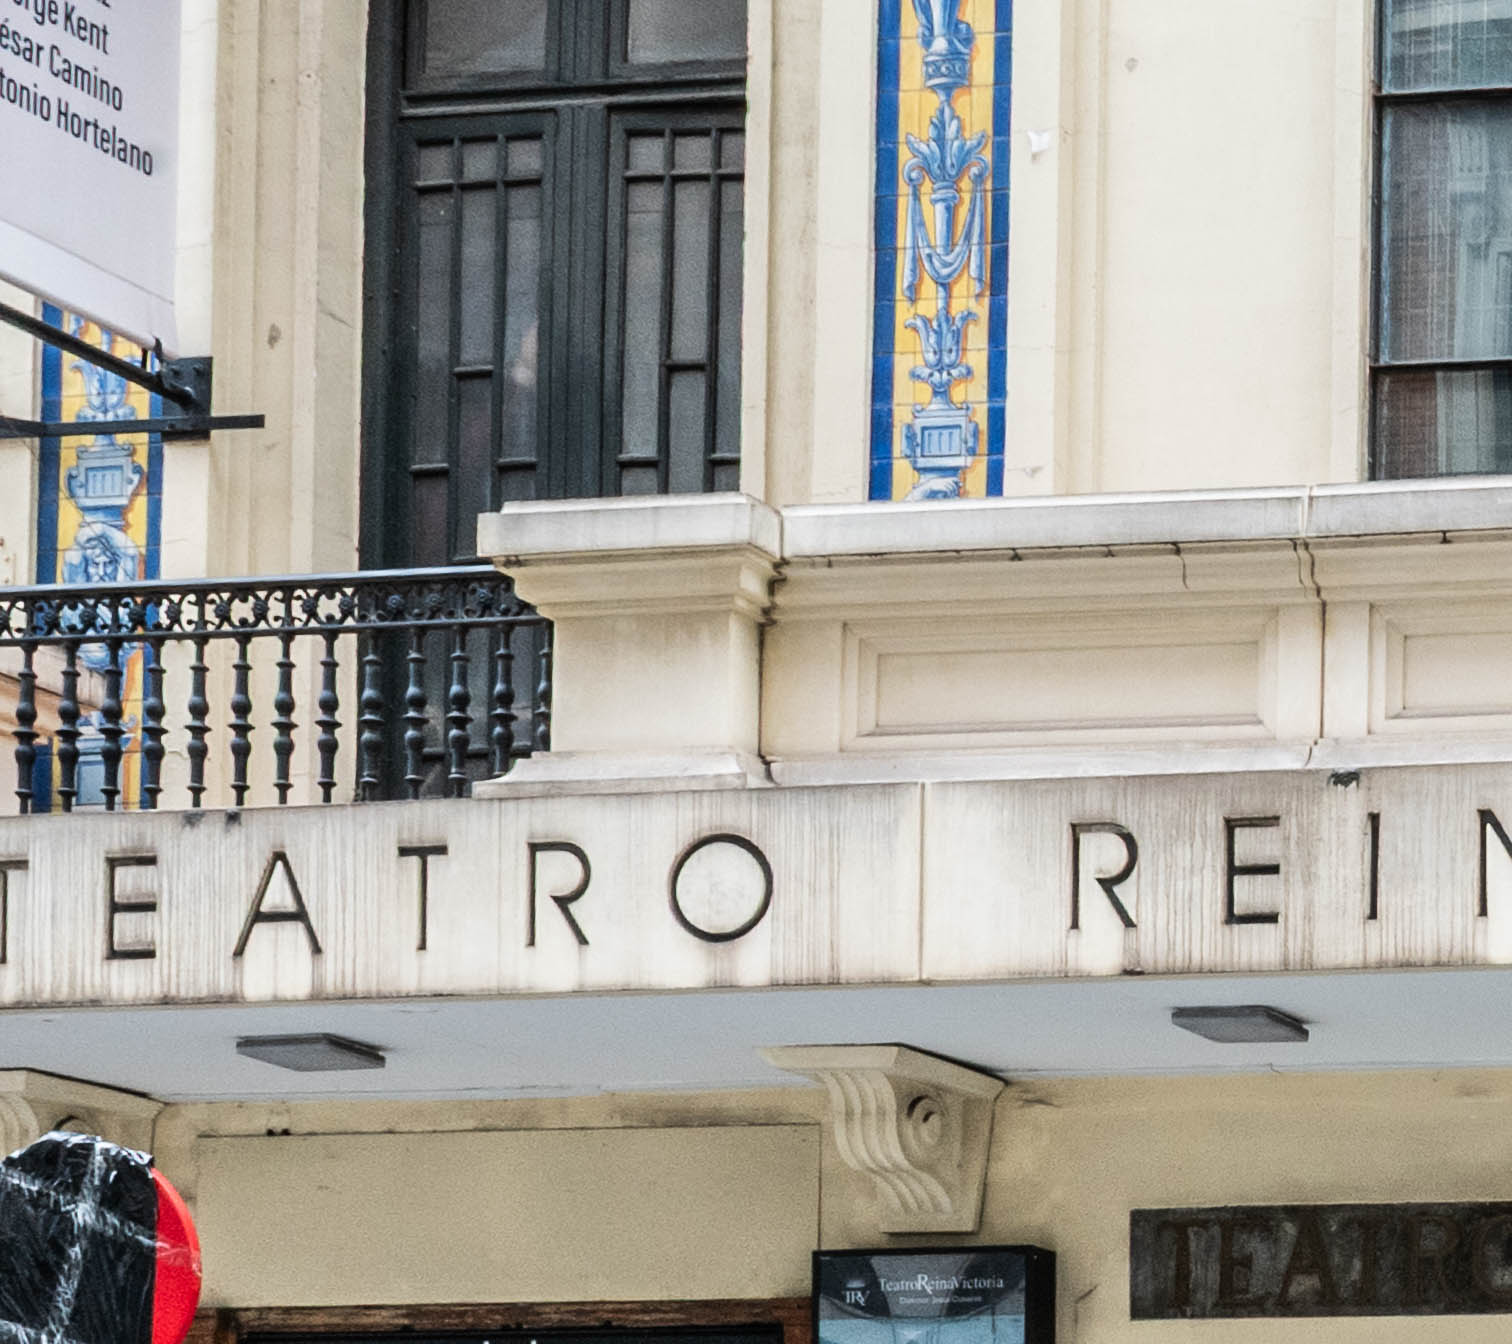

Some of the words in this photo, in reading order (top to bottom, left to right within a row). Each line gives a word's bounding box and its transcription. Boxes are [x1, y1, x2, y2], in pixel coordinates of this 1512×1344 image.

[64, 1, 109, 55] Kent
[49, 45, 123, 111] Camino
[57, 97, 153, 176] Hortelano
